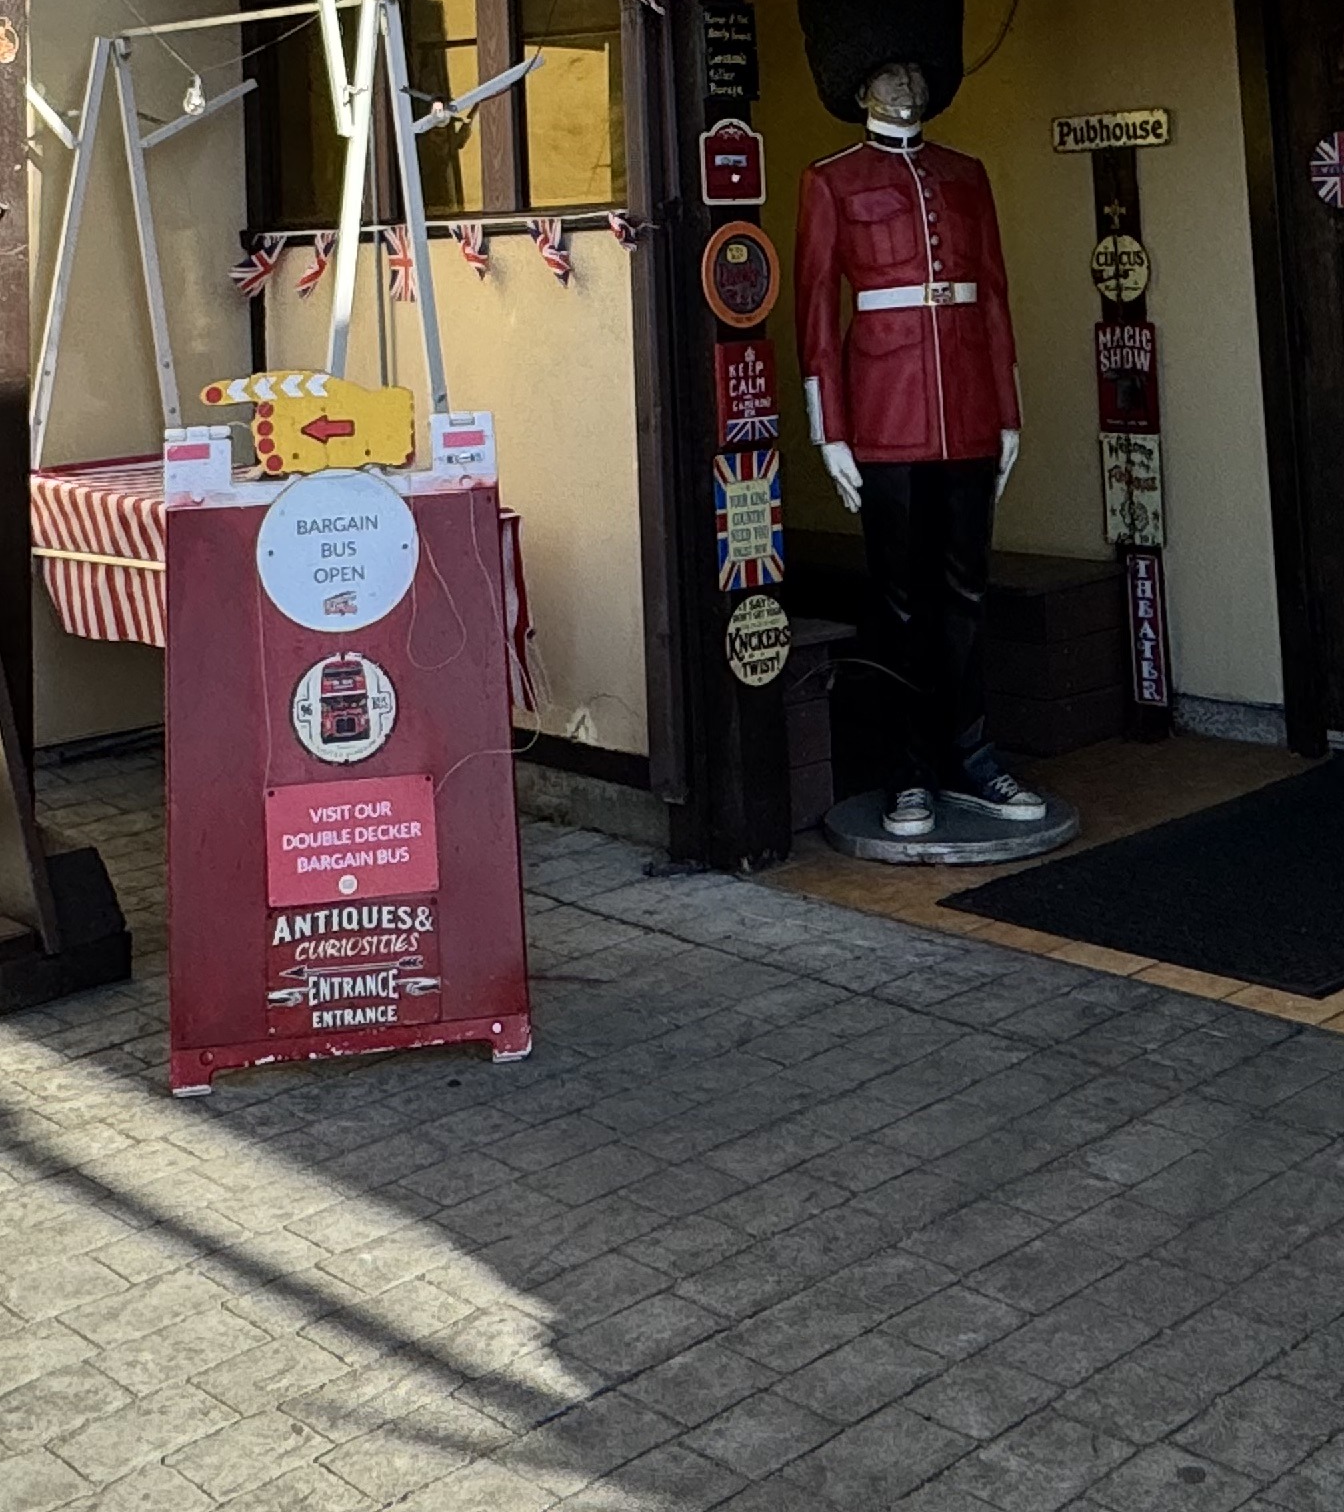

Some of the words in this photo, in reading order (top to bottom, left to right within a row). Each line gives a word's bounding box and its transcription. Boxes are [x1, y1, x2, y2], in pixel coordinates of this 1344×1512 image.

[1057, 118, 1164, 147] Pubhouse
[1098, 326, 1152, 351] MAGIC
[729, 361, 764, 378] KEEP
[1099, 349, 1152, 373] SHOW
[729, 377, 766, 398] CALM
[296, 514, 379, 536] BARGAIN
[321, 542, 357, 559] BUS
[313, 564, 366, 585] OPEN
[309, 804, 353, 824] VISIT
[354, 801, 393, 819] OUR
[282, 829, 352, 851] DOUBLE
[354, 821, 423, 843] DECKER
[296, 850, 375, 874] BARGAIN
[376, 846, 410, 866] BUS
[294, 931, 420, 962] CURIOSITIES
[307, 968, 400, 1006] ENTRANCE
[312, 1004, 399, 1029] ENTRANCE
